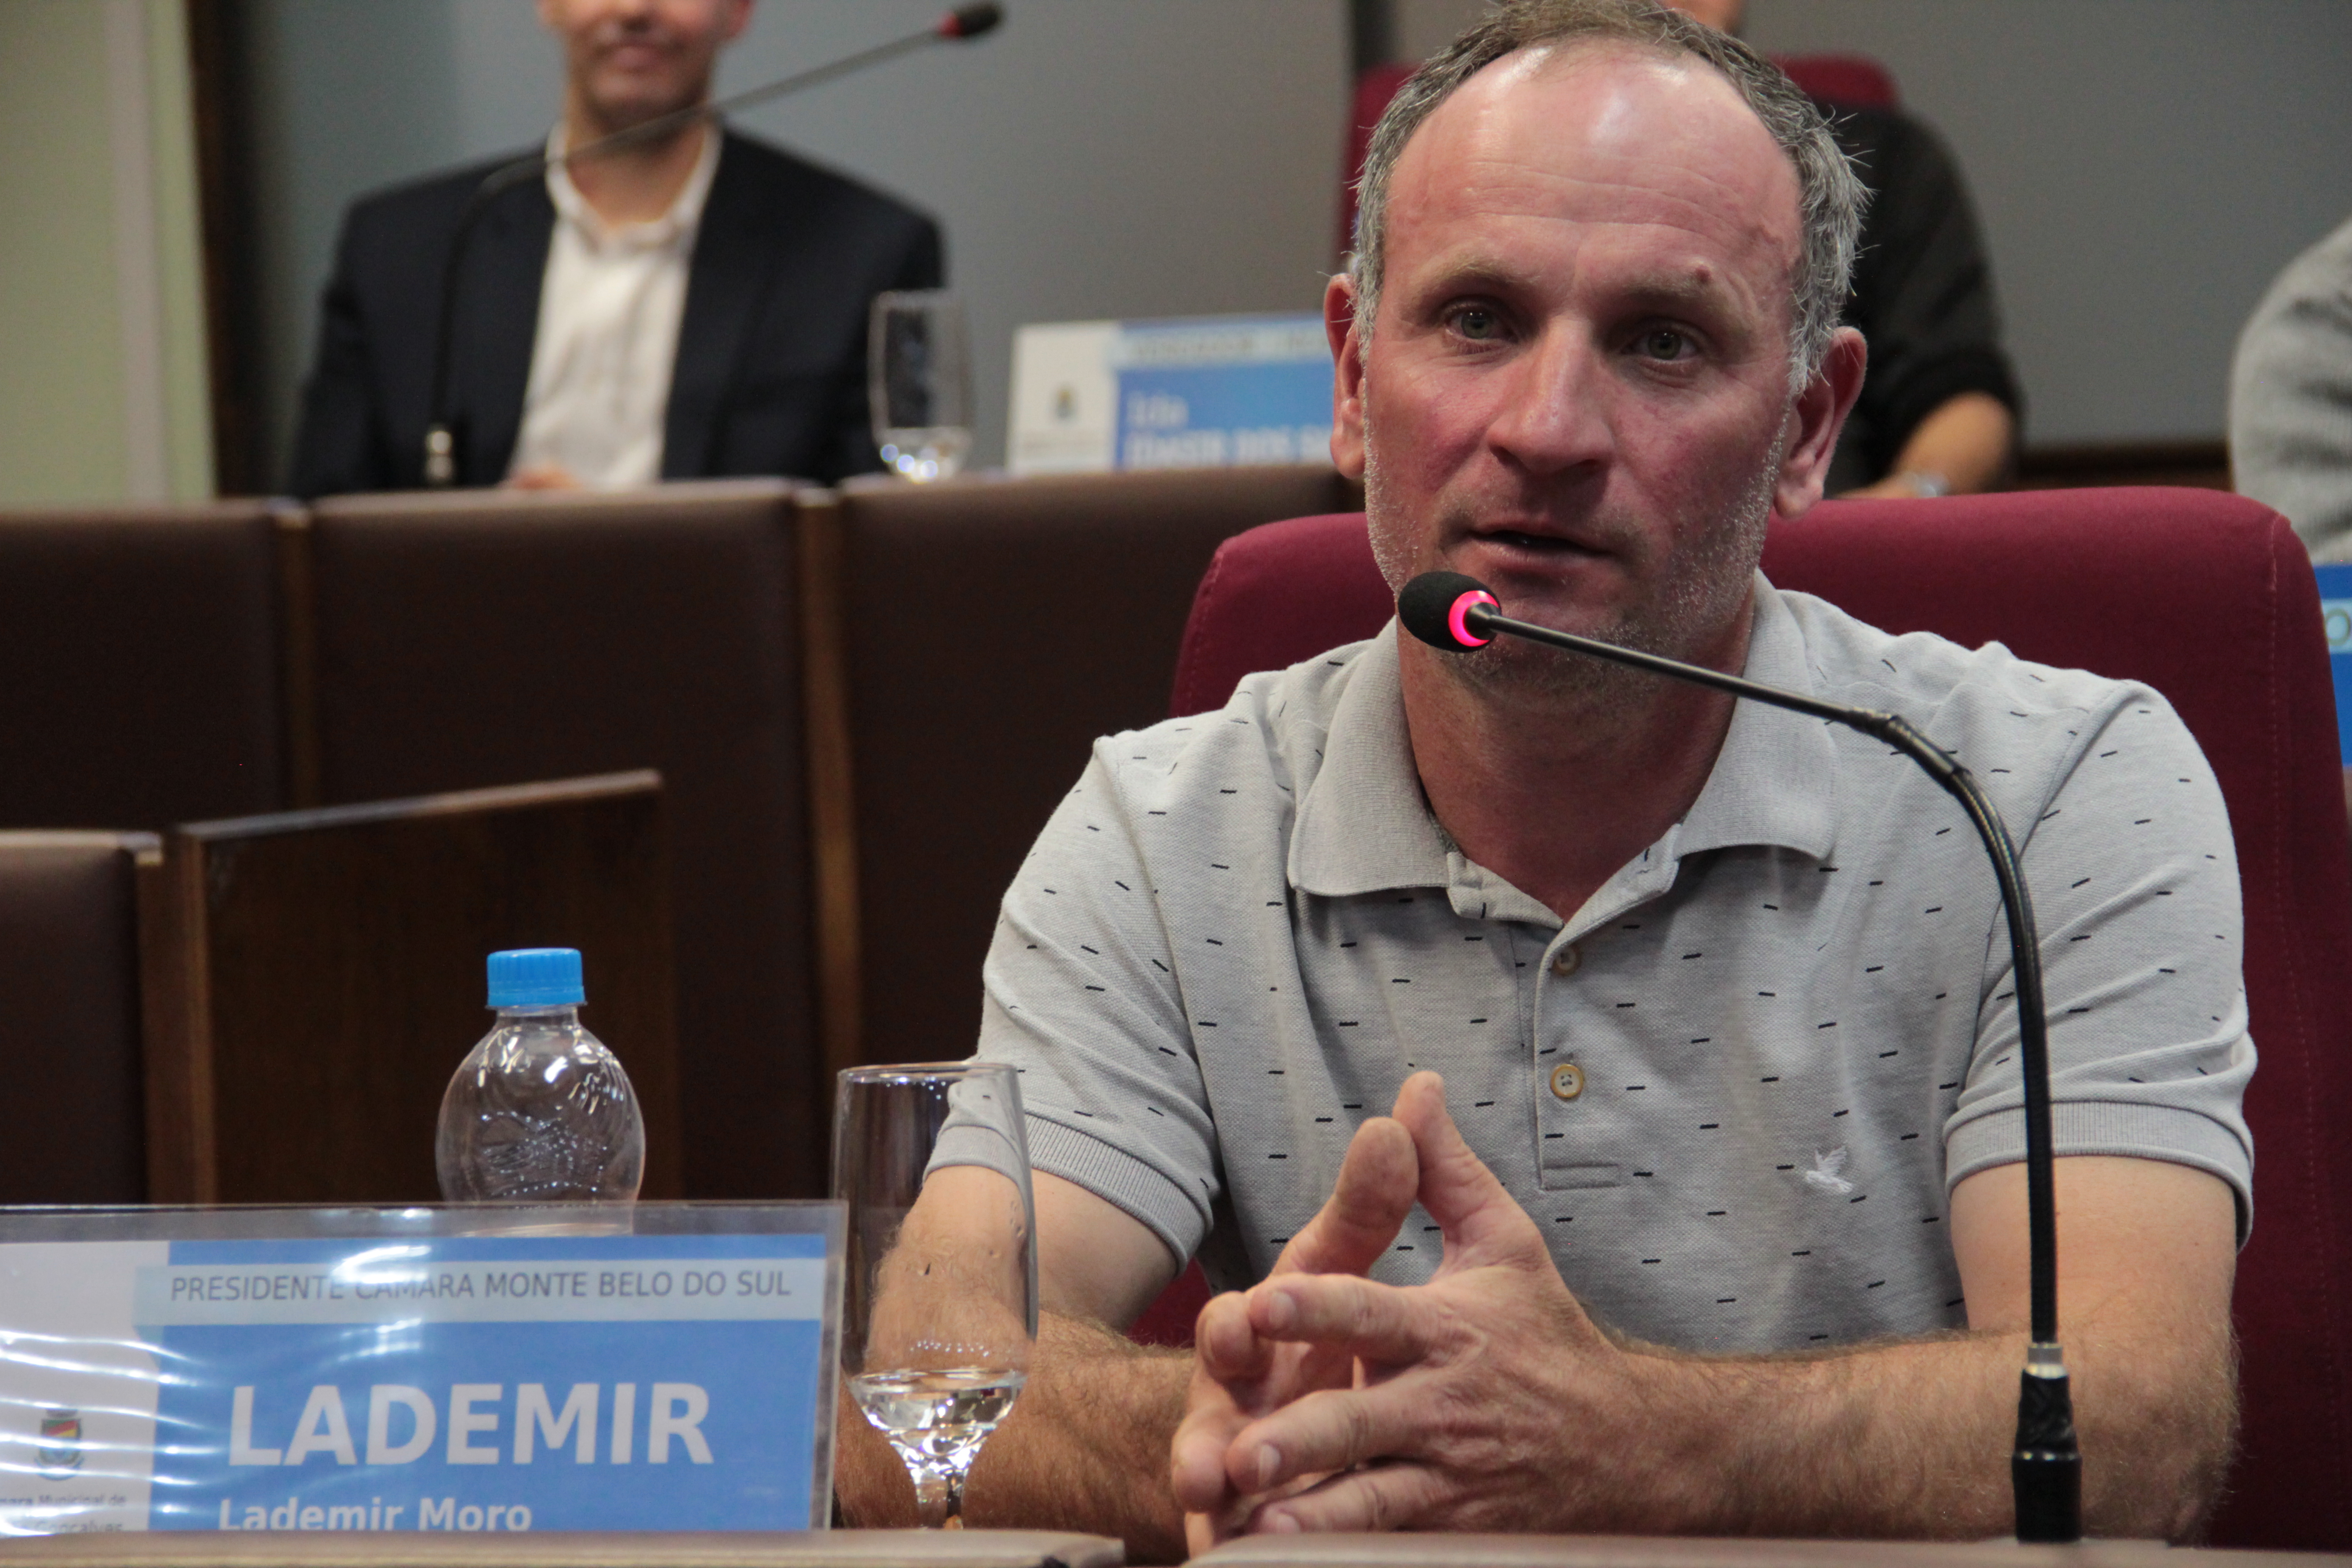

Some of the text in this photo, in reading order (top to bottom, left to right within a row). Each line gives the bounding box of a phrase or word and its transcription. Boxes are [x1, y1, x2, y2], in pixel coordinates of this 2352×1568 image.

[171, 1275, 344, 1301] PRESIDENTE
[485, 1272, 587, 1298] MONTE
[599, 1271, 673, 1297] BELO
[683, 1270, 726, 1296] DO
[736, 1269, 792, 1295] SUL
[229, 1382, 714, 1466] LADEMIR
[110, 1495, 127, 1507] de
[219, 1496, 533, 1531] Lademir Moro
